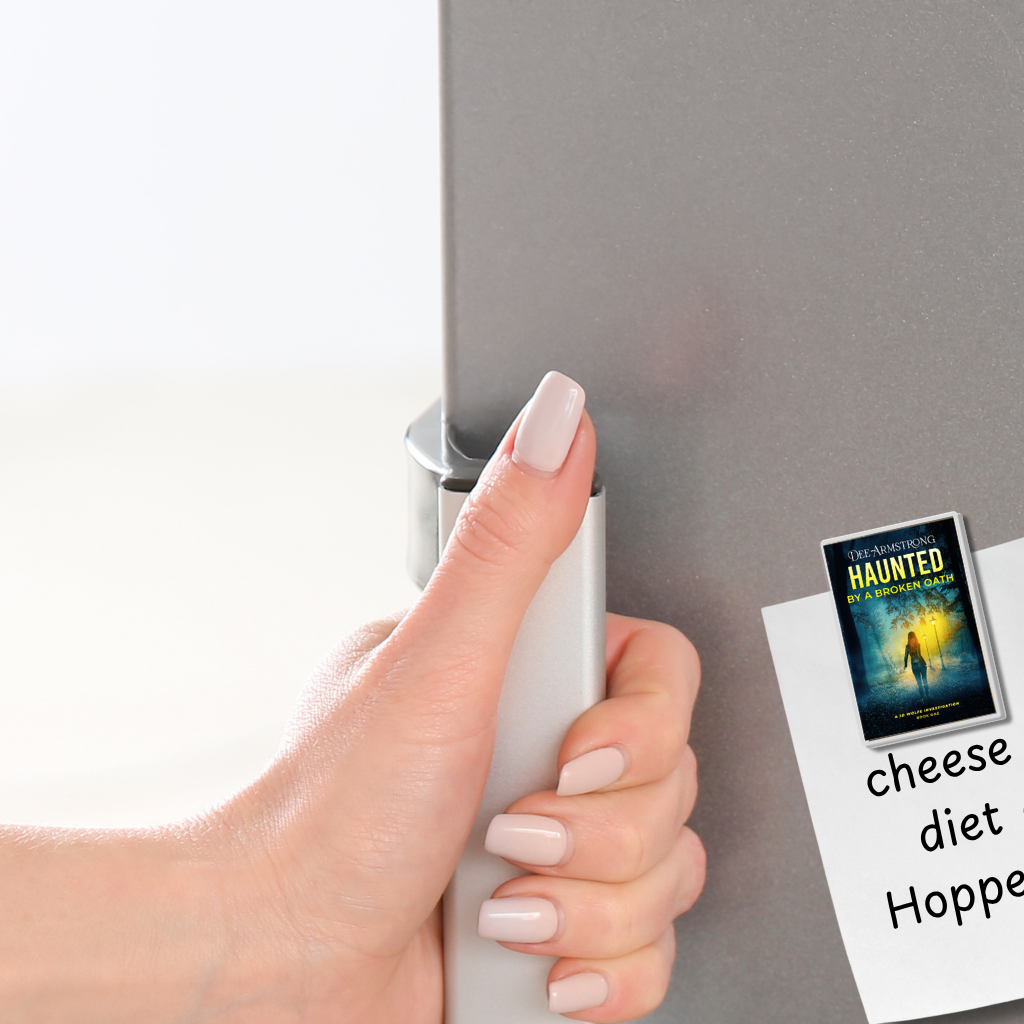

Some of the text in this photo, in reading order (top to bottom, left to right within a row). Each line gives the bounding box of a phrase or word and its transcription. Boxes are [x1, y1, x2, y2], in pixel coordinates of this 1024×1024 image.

[847, 534, 936, 562] DEE ARMSTRONG
[847, 547, 944, 590] HAUNTED
[847, 573, 954, 604] BY A BROKEN OATH
[866, 738, 1012, 797] cheese
[920, 803, 1004, 852] diet
